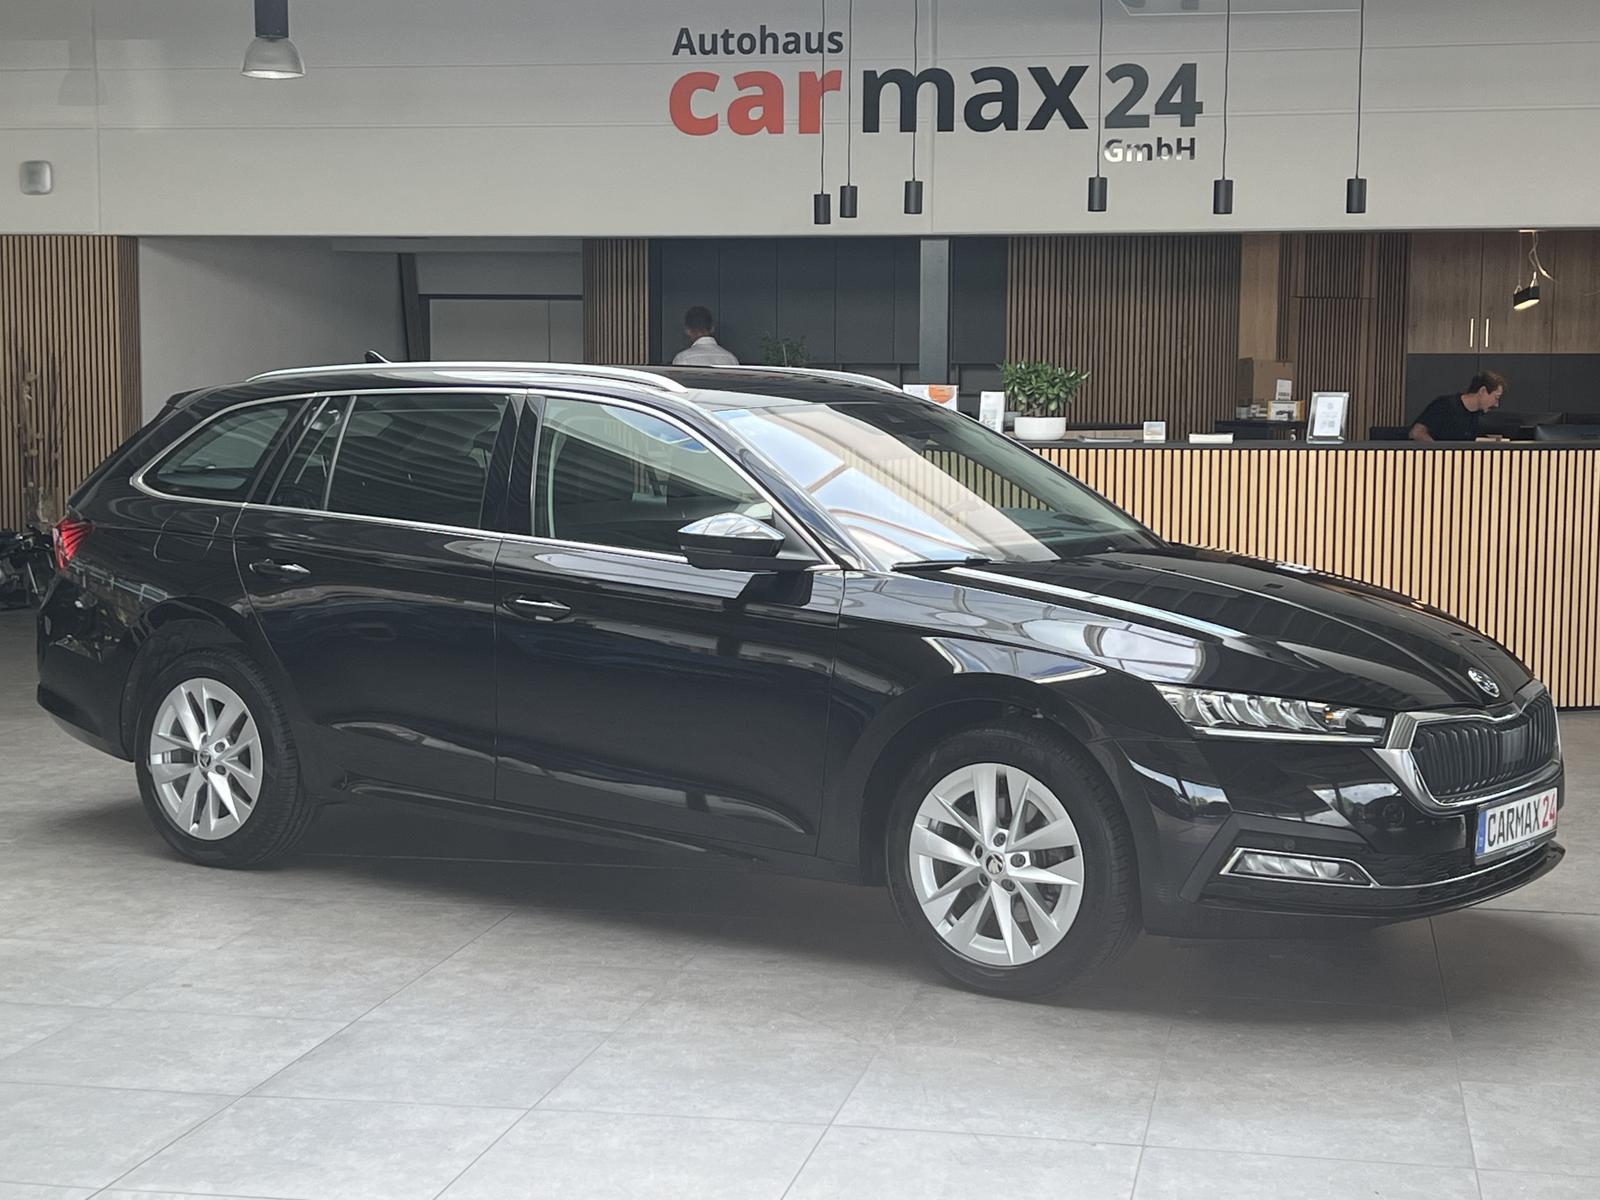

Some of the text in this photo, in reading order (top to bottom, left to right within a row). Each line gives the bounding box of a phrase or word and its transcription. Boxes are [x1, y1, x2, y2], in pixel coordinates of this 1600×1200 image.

[672, 25, 844, 56] Autohaus
[1104, 62, 1204, 130] 24
[1104, 136, 1196, 163] GmbH
